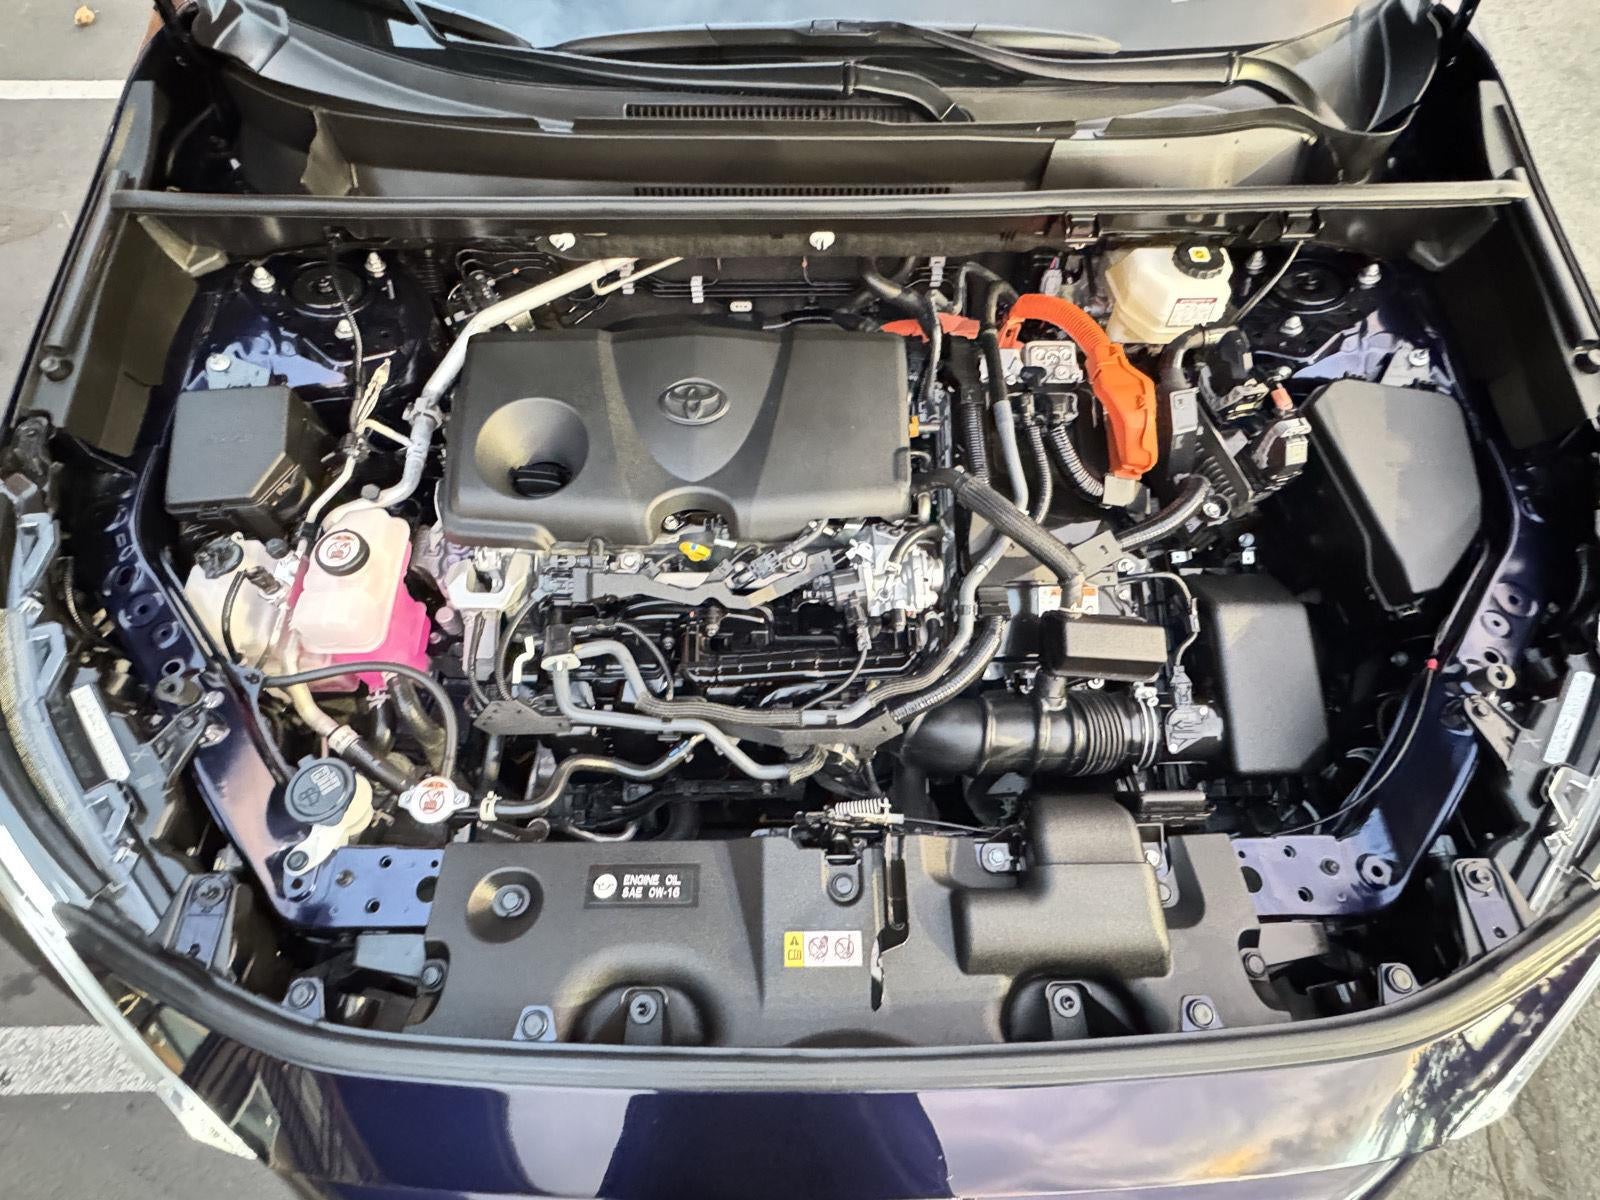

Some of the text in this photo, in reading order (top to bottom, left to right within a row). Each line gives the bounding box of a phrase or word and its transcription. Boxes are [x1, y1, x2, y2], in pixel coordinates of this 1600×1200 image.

[622, 873, 682, 886] ENGINE OIL
[621, 886, 643, 899] SAE
